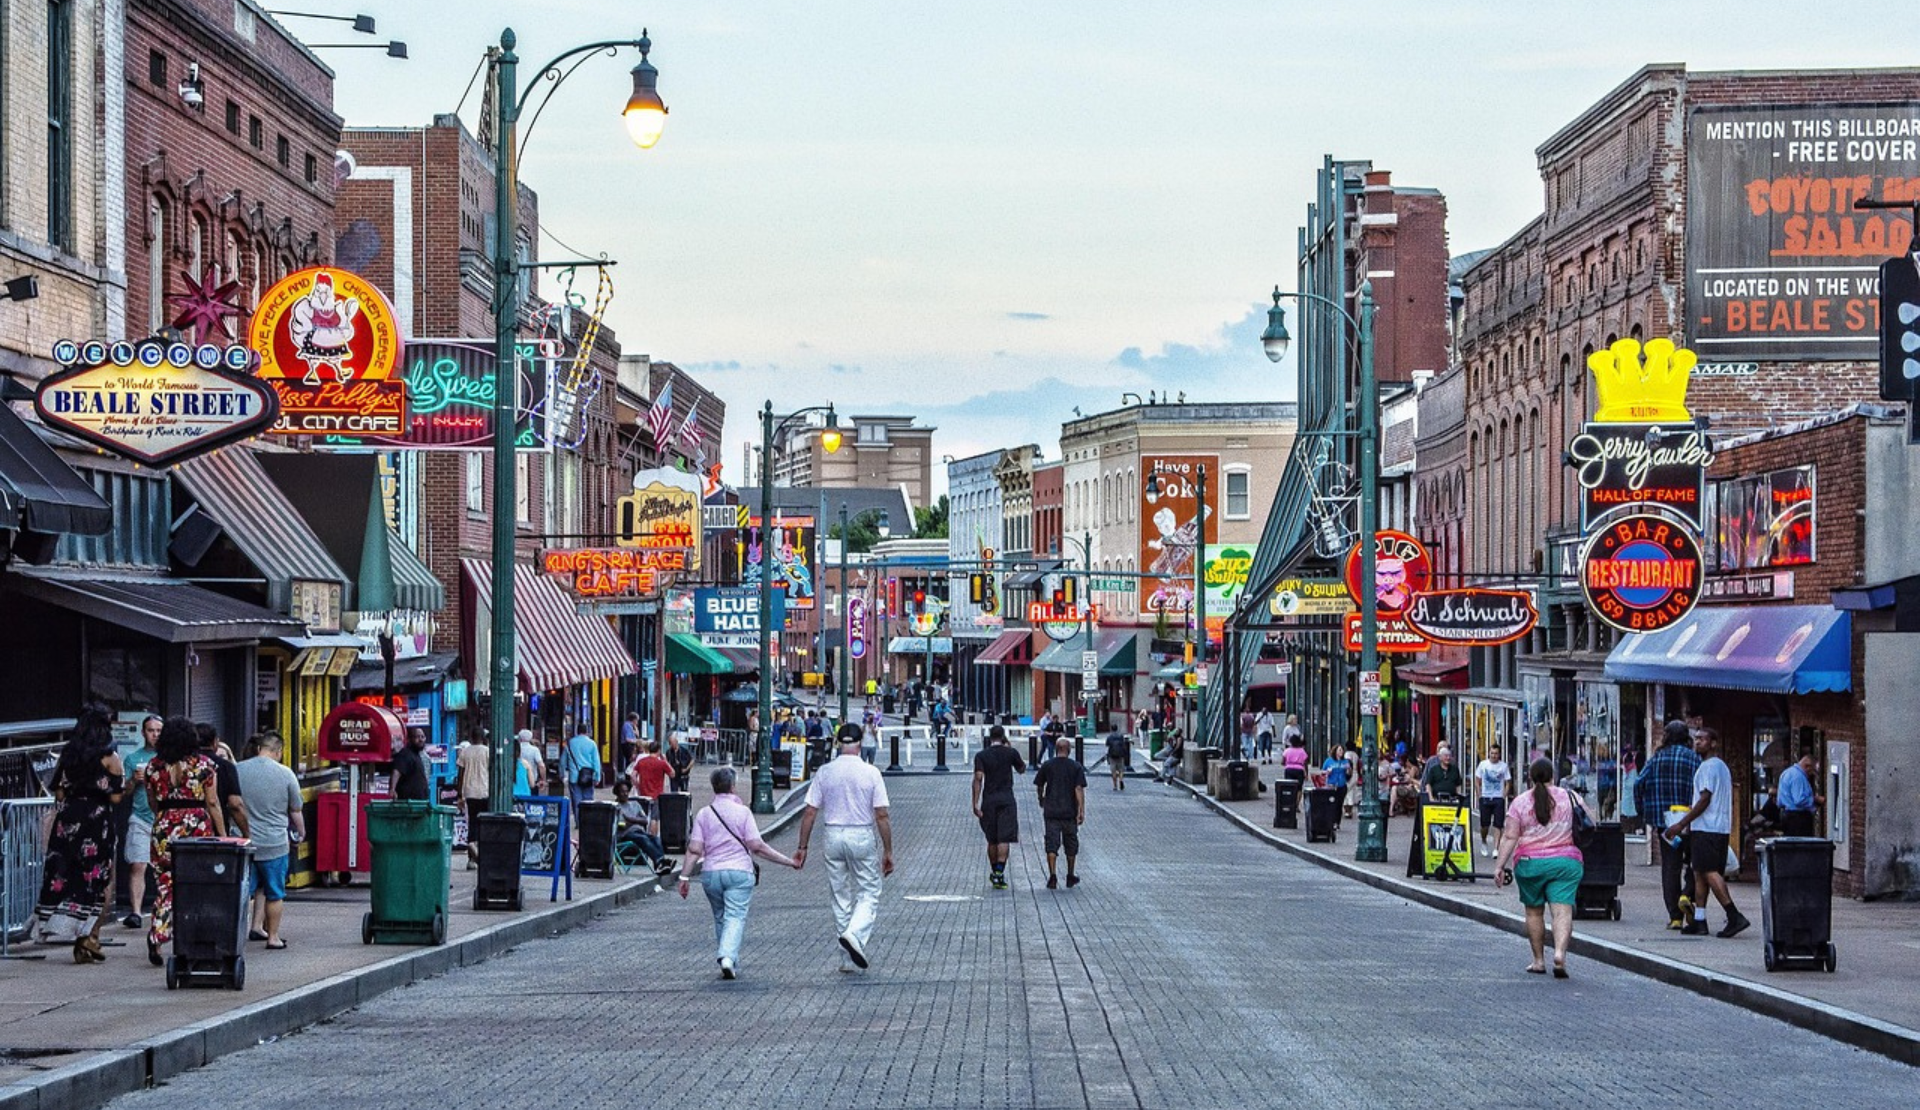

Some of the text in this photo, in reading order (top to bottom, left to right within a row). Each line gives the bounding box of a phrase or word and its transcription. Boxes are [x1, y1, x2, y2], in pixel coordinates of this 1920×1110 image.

[1706, 121, 1785, 140] MENTION
[1792, 120, 1832, 138] THIS
[1789, 142, 1838, 162] FREE
[1846, 140, 1916, 161] COVER
[1744, 176, 1873, 216] COYOTE
[1704, 278, 1779, 297] LOCATED
[1786, 278, 1809, 296] ON
[1816, 278, 1849, 295] THE
[262, 291, 288, 328] PEACE
[288, 277, 311, 296] AND
[343, 280, 389, 370] CHICKEN GREASE
[1727, 299, 1831, 331] BEALE
[57, 343, 248, 365] WELCOME
[1692, 363, 1751, 375] AMAR
[105, 377, 200, 390] to World Famous
[53, 390, 251, 416] BEALE STREET
[302, 416, 344, 430] CITY
[347, 416, 399, 431] CAFE
[1154, 459, 1191, 474] Have
[1571, 434, 1647, 488] Jerry
[1593, 488, 1697, 502] HALL OF FAME
[1617, 519, 1669, 544] BAR
[611, 551, 685, 570] PALACE
[576, 573, 655, 595] CAFE
[1587, 560, 1695, 588] RESTAURANT
[706, 597, 761, 614] BLUE
[1411, 595, 1530, 622] A. Schwab
[1597, 592, 1690, 628] 159 BEALE
[713, 614, 761, 631] HALL
[737, 636, 760, 645] JOIN
[1084, 660, 1097, 669] 25
[339, 720, 372, 728] GRAB
